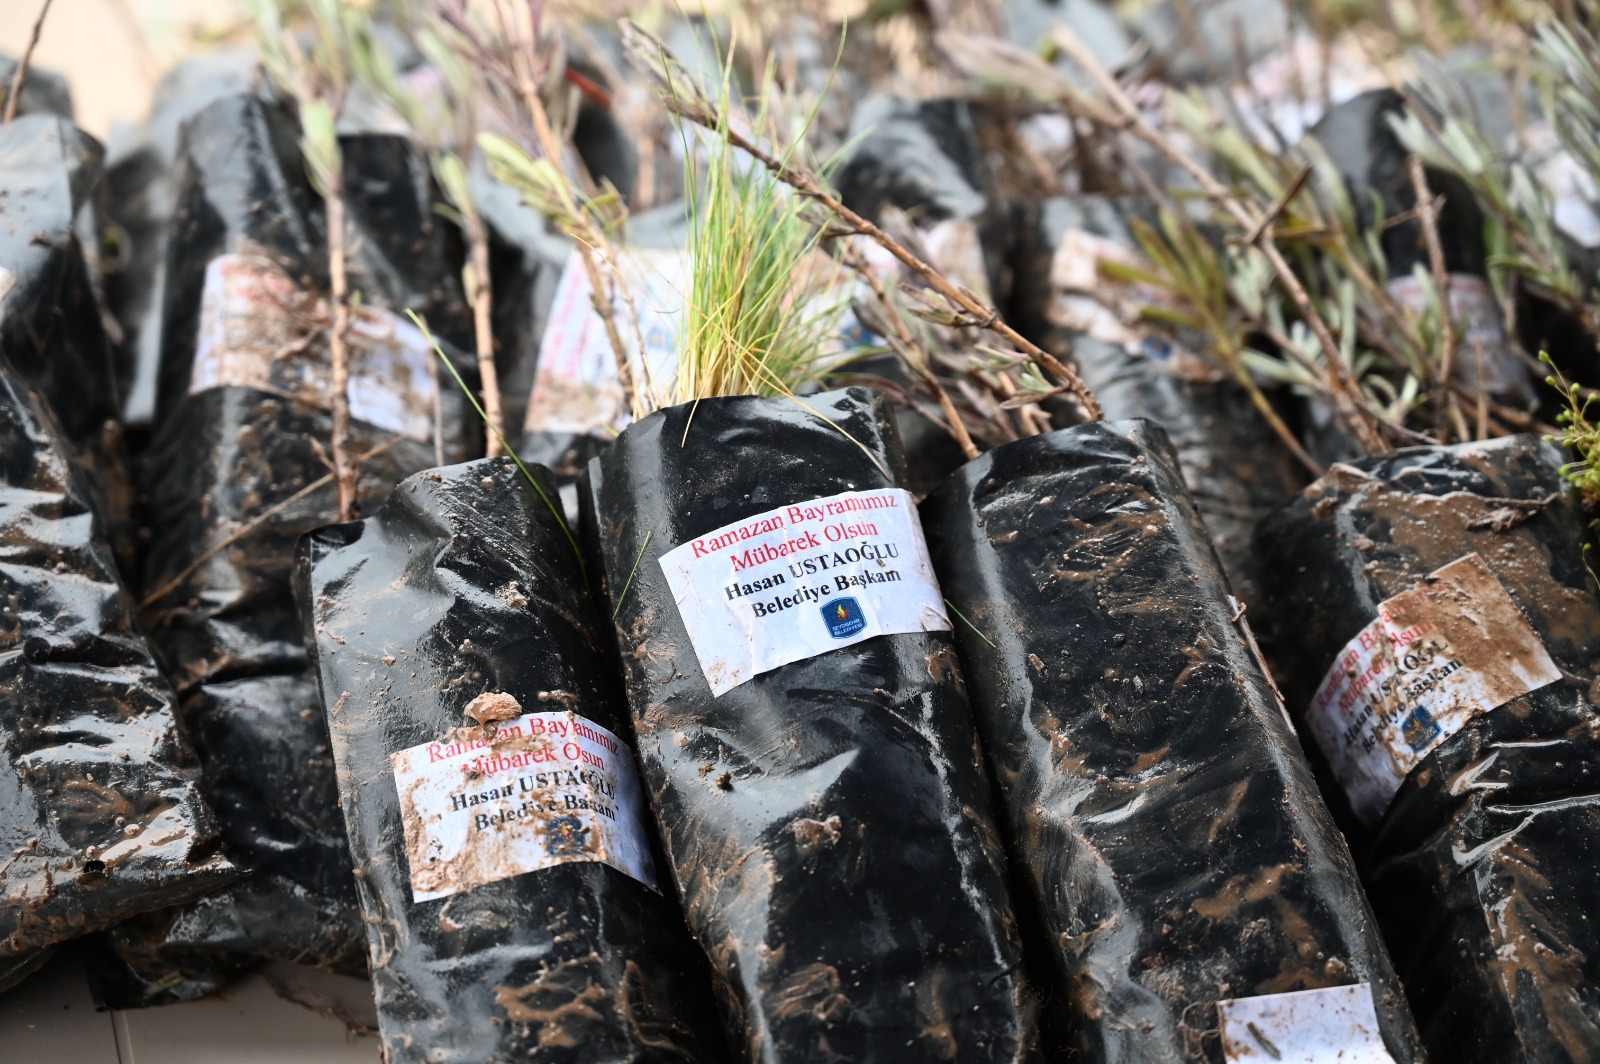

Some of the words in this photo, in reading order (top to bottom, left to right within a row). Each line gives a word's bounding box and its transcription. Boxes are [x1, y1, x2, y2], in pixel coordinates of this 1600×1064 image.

[691, 515, 784, 558] Ramazan
[786, 495, 898, 524] Bayramımız
[730, 531, 821, 572] Mübarek
[824, 522, 878, 543] Olsun
[725, 573, 785, 601] Hasan
[788, 541, 899, 578] USTAOĞLU
[752, 584, 830, 618] Belediye
[451, 784, 513, 812] Hasan
